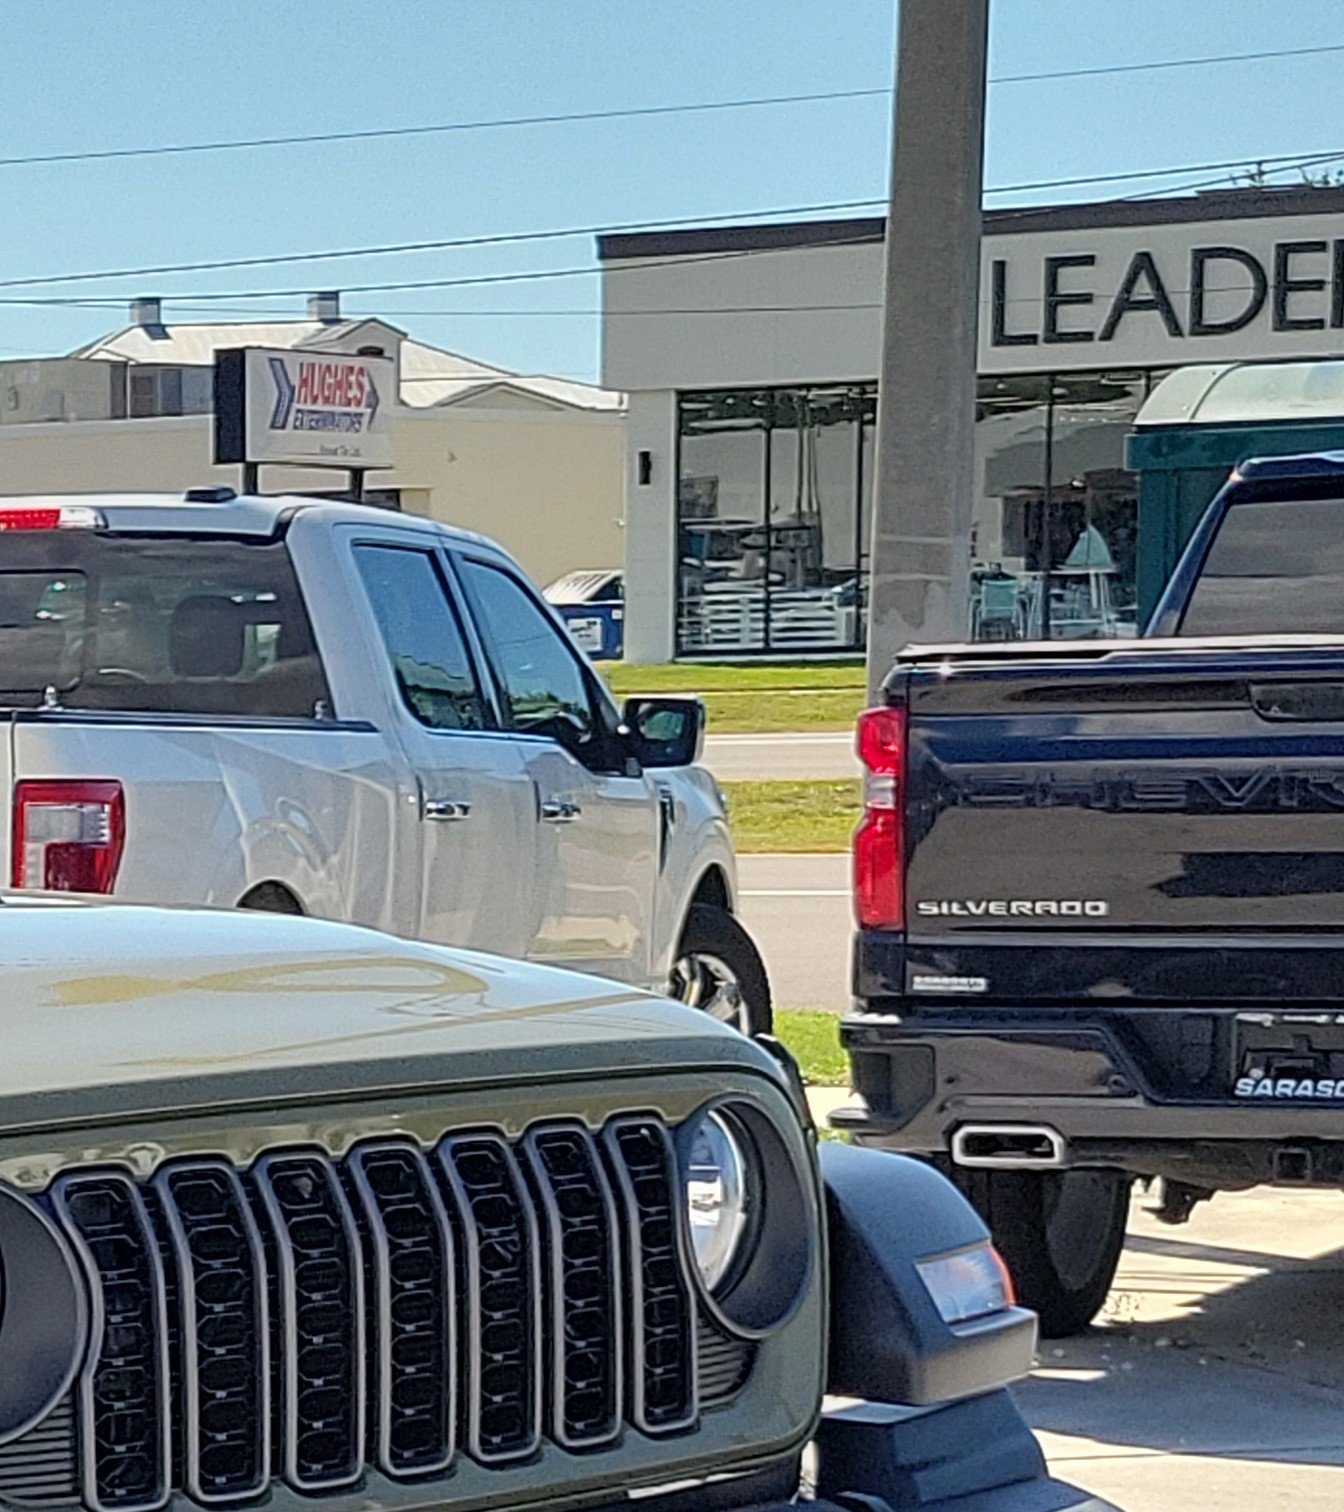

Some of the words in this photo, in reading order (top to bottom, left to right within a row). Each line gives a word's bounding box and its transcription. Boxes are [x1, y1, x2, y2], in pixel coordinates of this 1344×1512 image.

[991, 238, 1344, 347] LEADE
[296, 362, 365, 407] HUGHES
[917, 901, 1109, 916] SILVERADO
